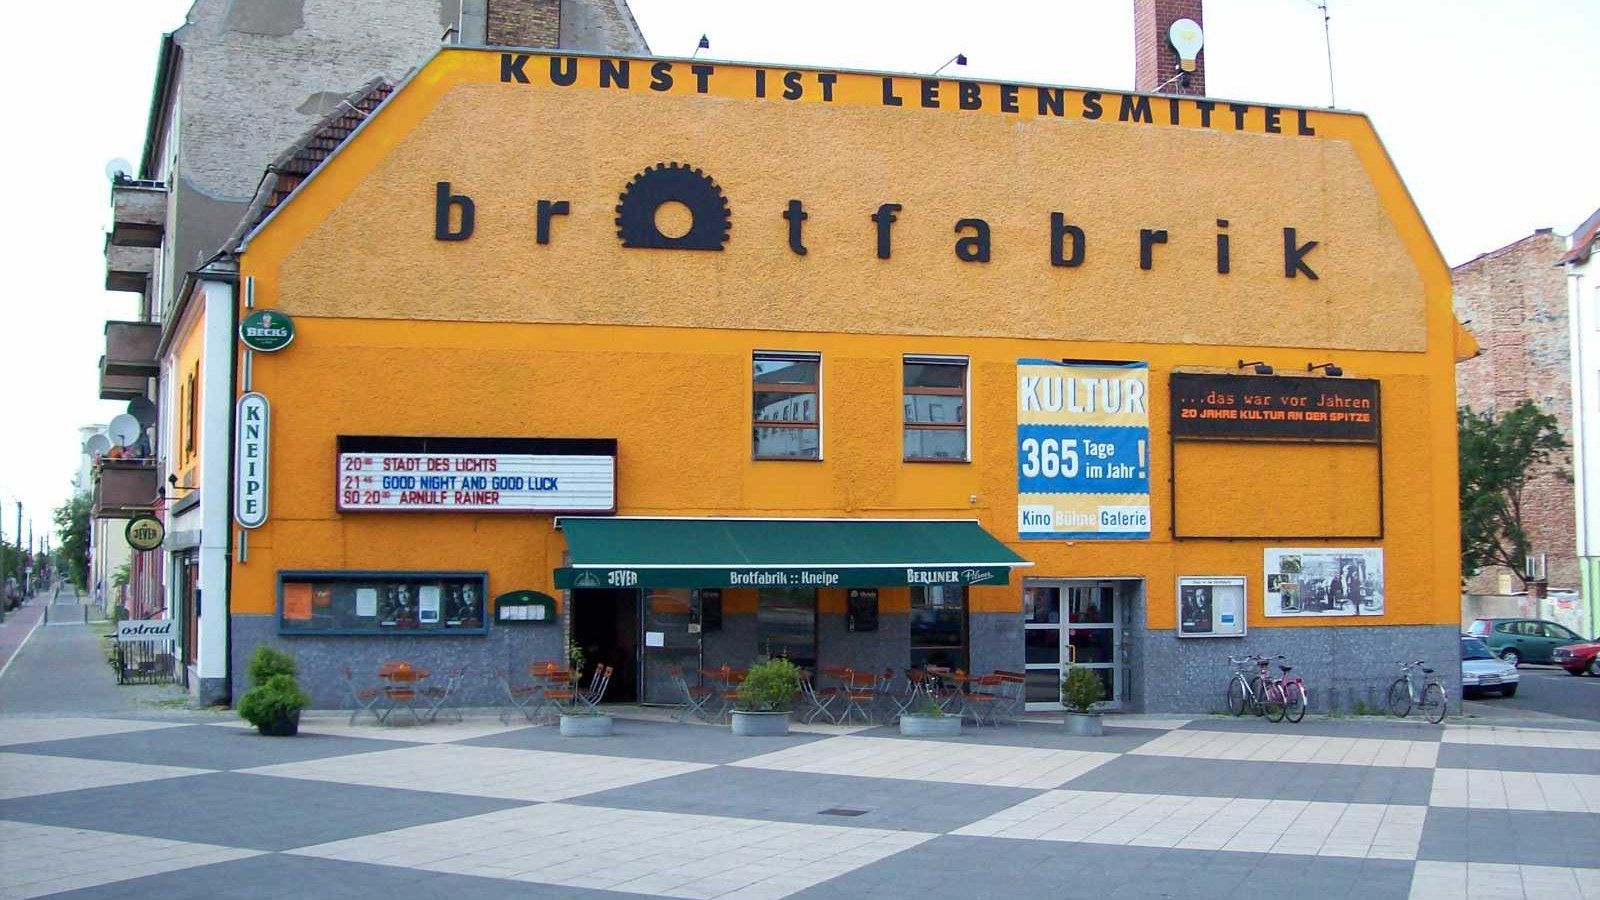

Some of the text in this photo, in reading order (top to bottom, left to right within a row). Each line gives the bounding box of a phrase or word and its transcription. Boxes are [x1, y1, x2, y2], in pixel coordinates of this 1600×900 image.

[500, 53, 1316, 137] KUNST IST LEBENSMITTEL
[1021, 374, 1145, 414] KULTUR
[1243, 393, 1272, 406] war
[1280, 396, 1308, 407] vor
[1316, 394, 1371, 409] Jahren
[1181, 408, 1371, 423] 20 JAHRE KULTUR AN DER SPITZE
[1083, 439, 1115, 459] Tage
[245, 405, 261, 515] KNEIPE
[383, 457, 422, 472] STADT
[427, 458, 450, 472] DES
[455, 458, 497, 472] LICHTS
[1022, 438, 1079, 478] 365
[1085, 463, 1103, 479] im
[382, 475, 416, 490] GOOD
[420, 476, 457, 490] NIGHT
[461, 476, 487, 490] AND
[491, 476, 524, 490] GOOD
[527, 476, 558, 491] LUCK
[344, 490, 360, 504] SO
[399, 491, 447, 505] ARNULF
[454, 491, 499, 505] RAINER
[1022, 510, 1147, 526] Kino Bühne Galerie
[607, 569, 638, 587] JEVER
[730, 571, 787, 585] Brotfabrik
[801, 571, 839, 586] Kneipe
[907, 568, 959, 584] BERLINER
